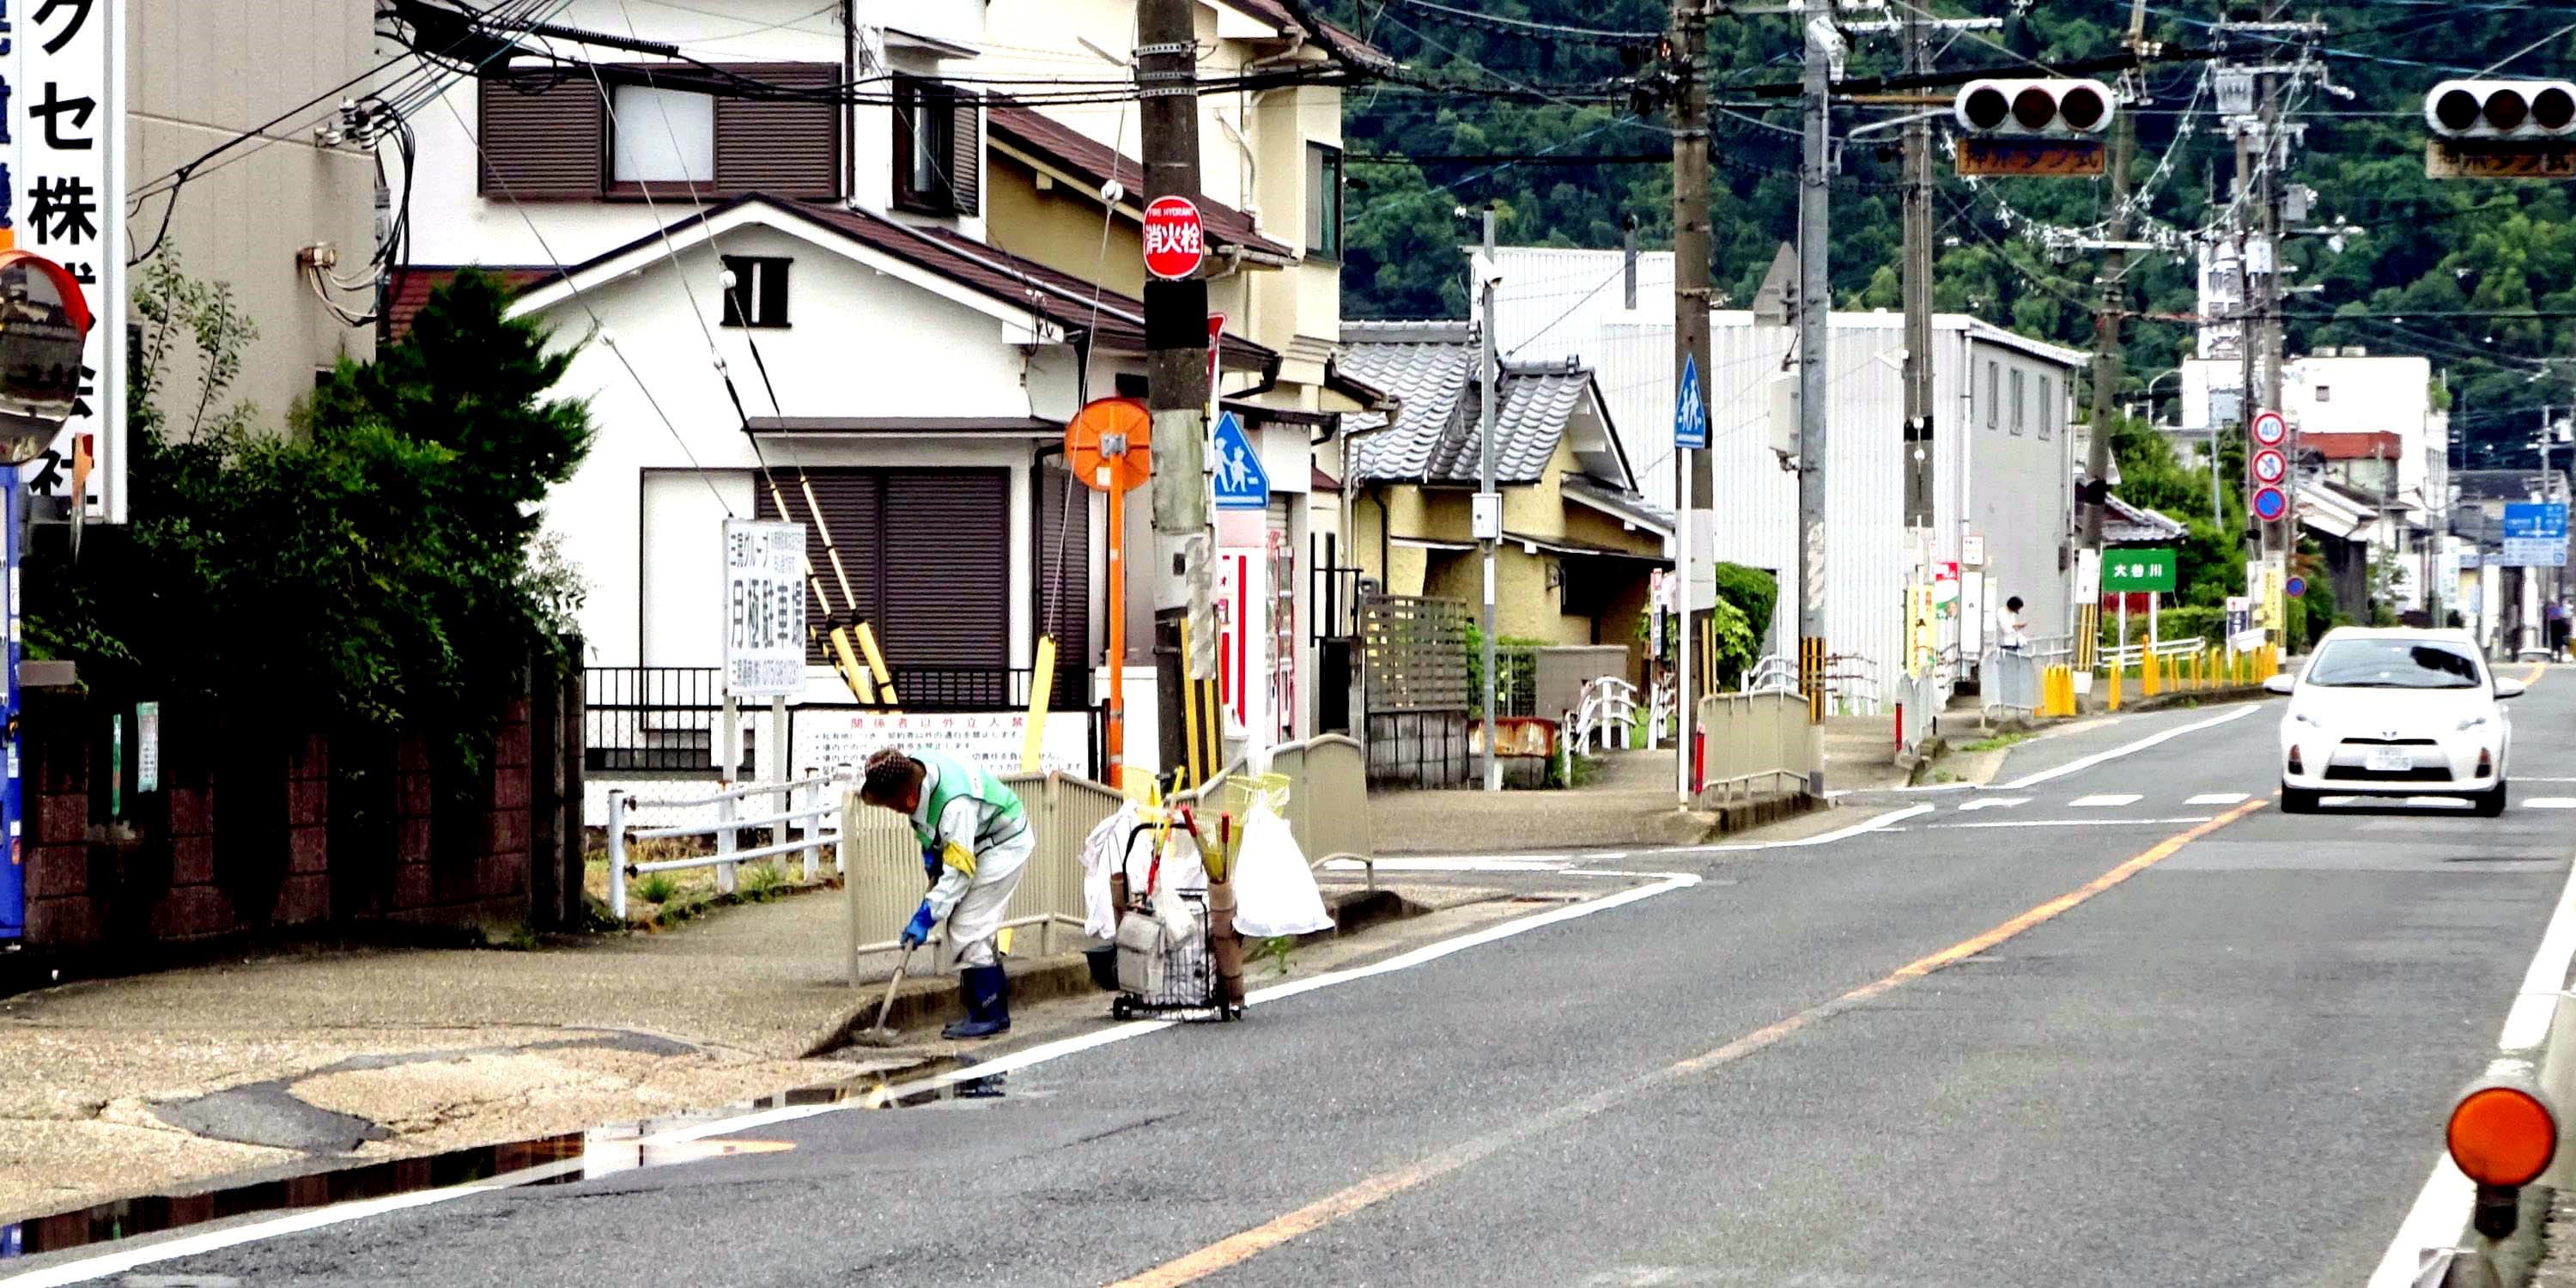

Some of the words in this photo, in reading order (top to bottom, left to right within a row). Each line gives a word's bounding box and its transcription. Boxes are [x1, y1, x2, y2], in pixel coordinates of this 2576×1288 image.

[1146, 222, 1200, 254] 消火栓
[2262, 421, 2279, 436] 40
[732, 578, 803, 649] 月極駐車場
[851, 717, 1046, 728] 関係者以外立入禁
